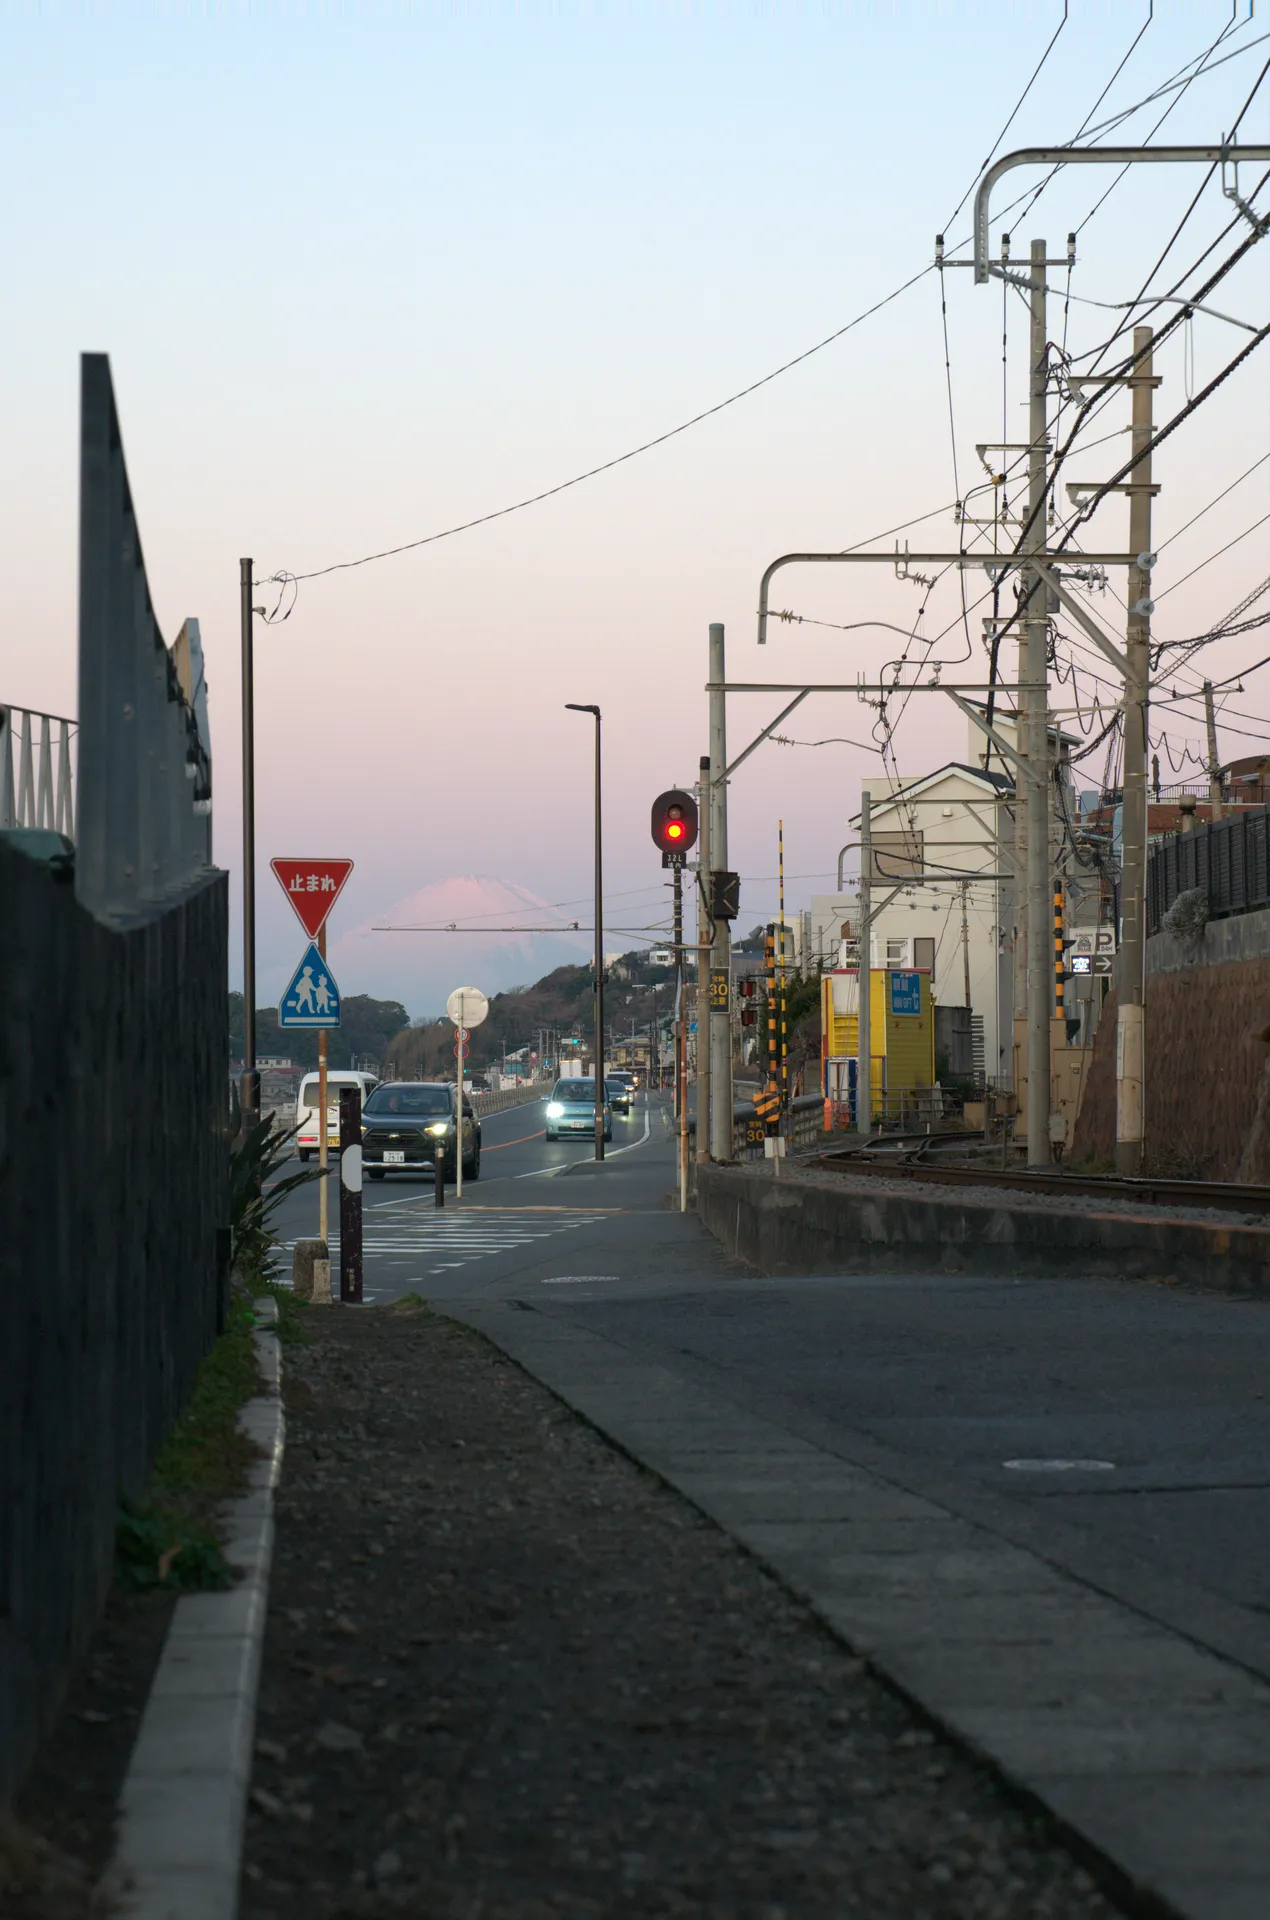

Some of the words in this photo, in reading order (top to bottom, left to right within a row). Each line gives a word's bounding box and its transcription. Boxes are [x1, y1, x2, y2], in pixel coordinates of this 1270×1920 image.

[667, 854, 682, 862] 32L
[288, 873, 337, 892] 止まれ
[1096, 932, 1113, 952] P
[709, 983, 729, 996] 30
[746, 1129, 765, 1142] 30
